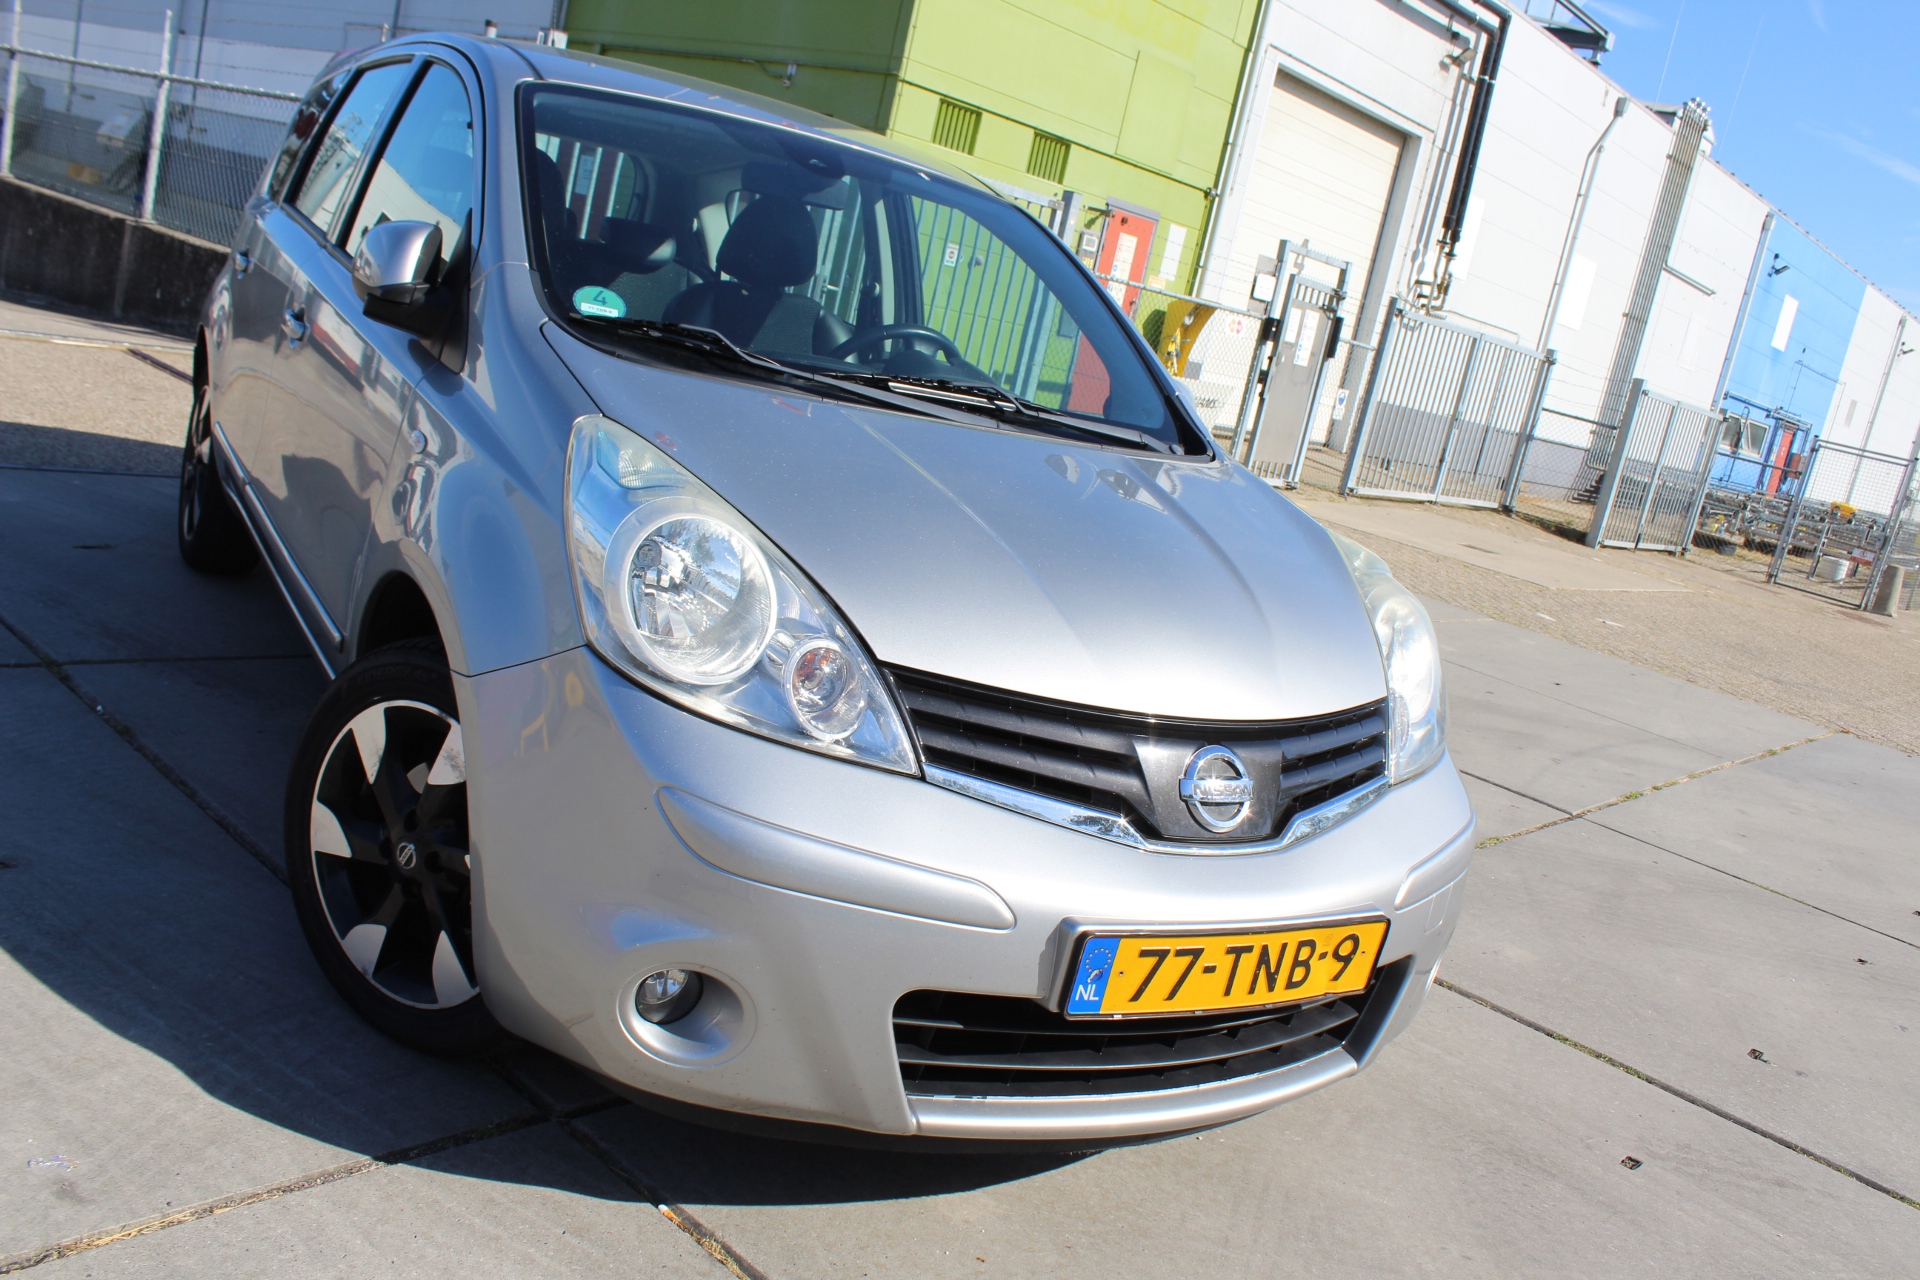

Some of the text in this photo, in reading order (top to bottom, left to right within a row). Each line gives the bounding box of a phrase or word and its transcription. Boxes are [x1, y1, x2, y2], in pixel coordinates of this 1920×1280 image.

[593, 290, 607, 305] 4
[1192, 783, 1254, 798] NISSAN
[1128, 932, 1360, 1003] 77-TNB-9
[1075, 983, 1099, 1001] NL
